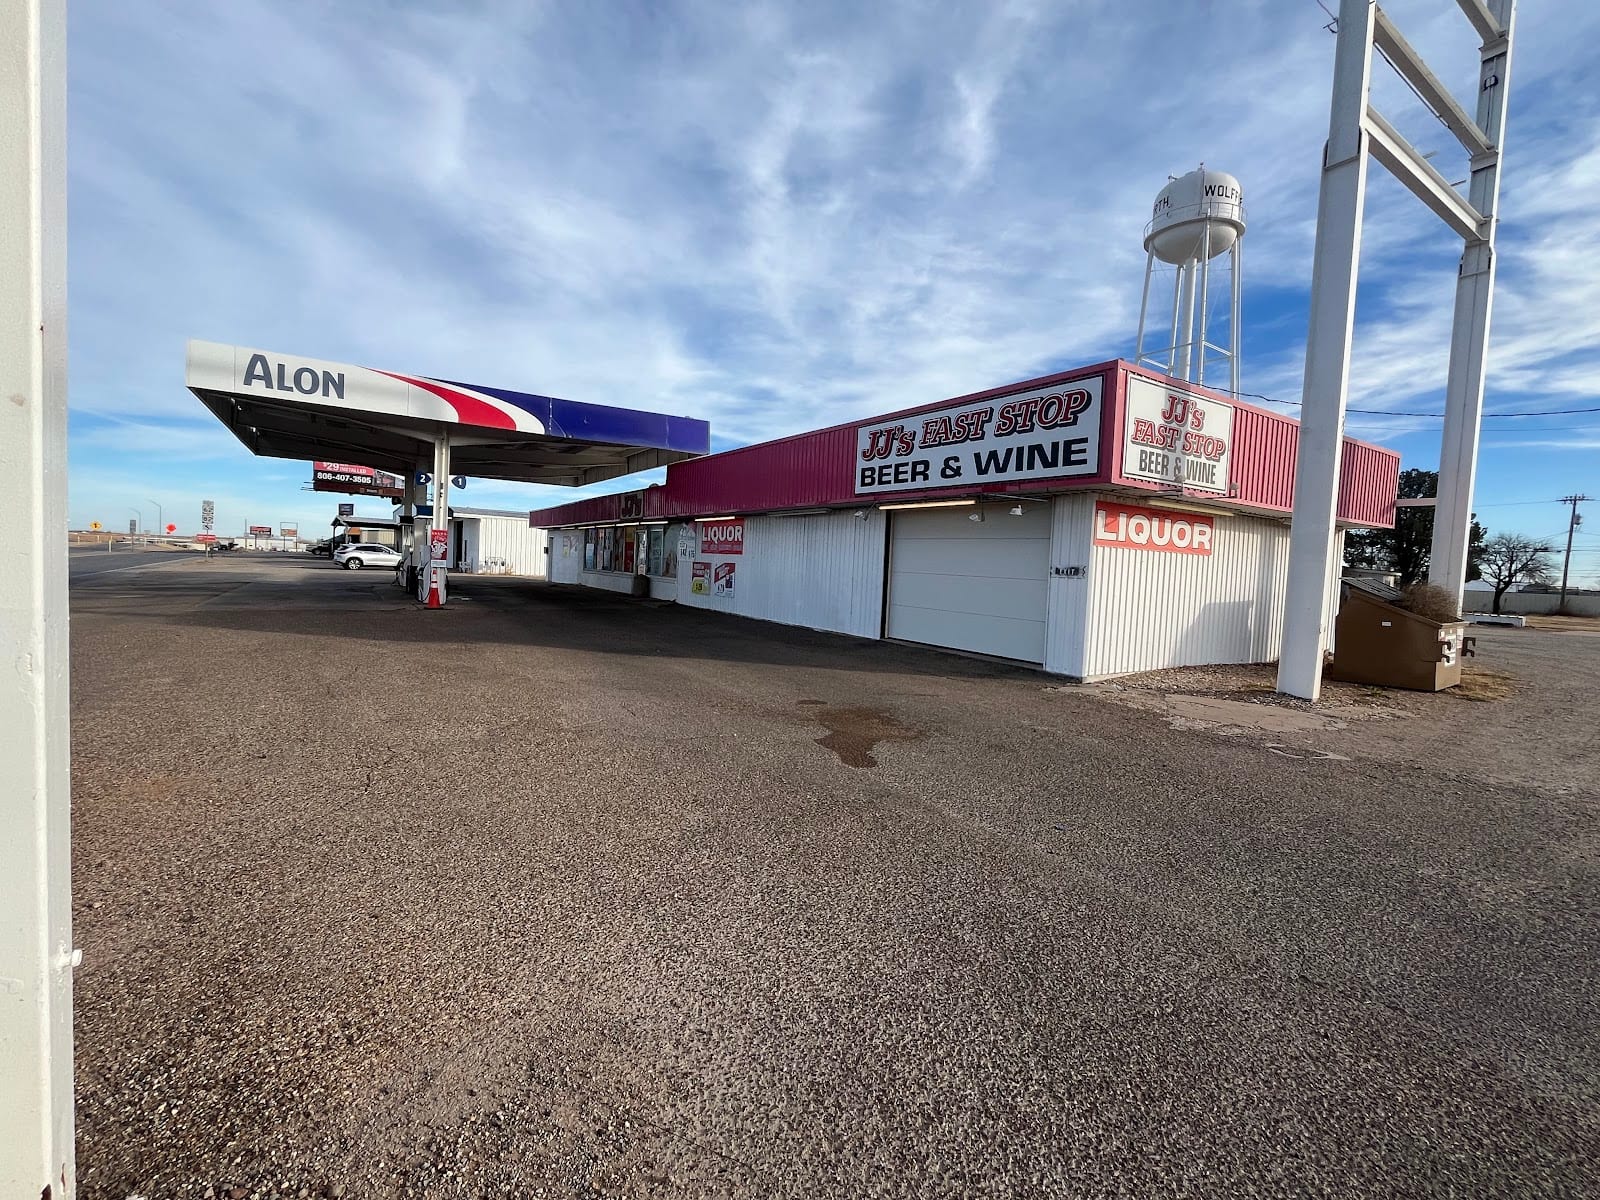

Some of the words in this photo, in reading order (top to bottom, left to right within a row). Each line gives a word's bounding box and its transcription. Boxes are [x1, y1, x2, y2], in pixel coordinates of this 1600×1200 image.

[919, 407, 993, 449] FAST
[995, 388, 1092, 437] STOP
[1131, 418, 1180, 452] FAST
[1182, 431, 1227, 462] STOP
[420, 474, 426, 483] 2
[457, 477, 463, 486] 1
[860, 460, 930, 488] BEER
[940, 455, 963, 479] &
[974, 437, 1089, 476] WINE
[1138, 449, 1170, 477] BEER
[1173, 456, 1182, 482] &
[1186, 459, 1217, 485] WINE
[702, 526, 742, 544] LIQUOR
[1096, 510, 1213, 550] LIQUOR
